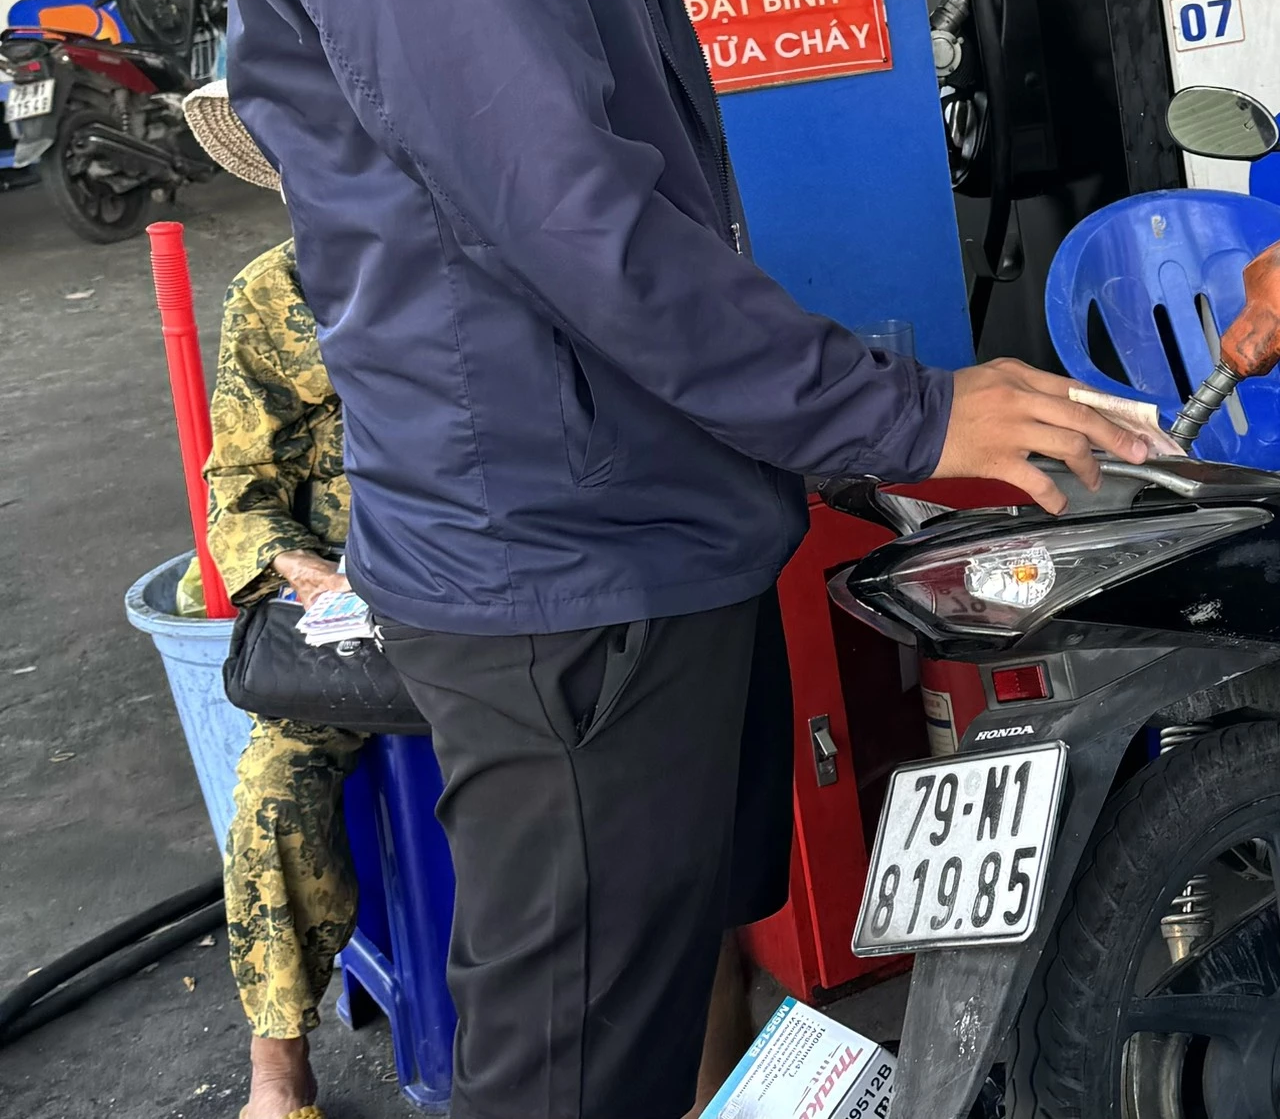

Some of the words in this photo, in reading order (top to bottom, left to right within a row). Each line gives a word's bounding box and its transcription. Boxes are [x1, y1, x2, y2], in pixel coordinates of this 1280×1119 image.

[774, 18, 870, 59] CHÁY
[974, 725, 1035, 741] HONDA
[870, 846, 1038, 939] 819.85
[846, 1064, 892, 1119] 9512B
